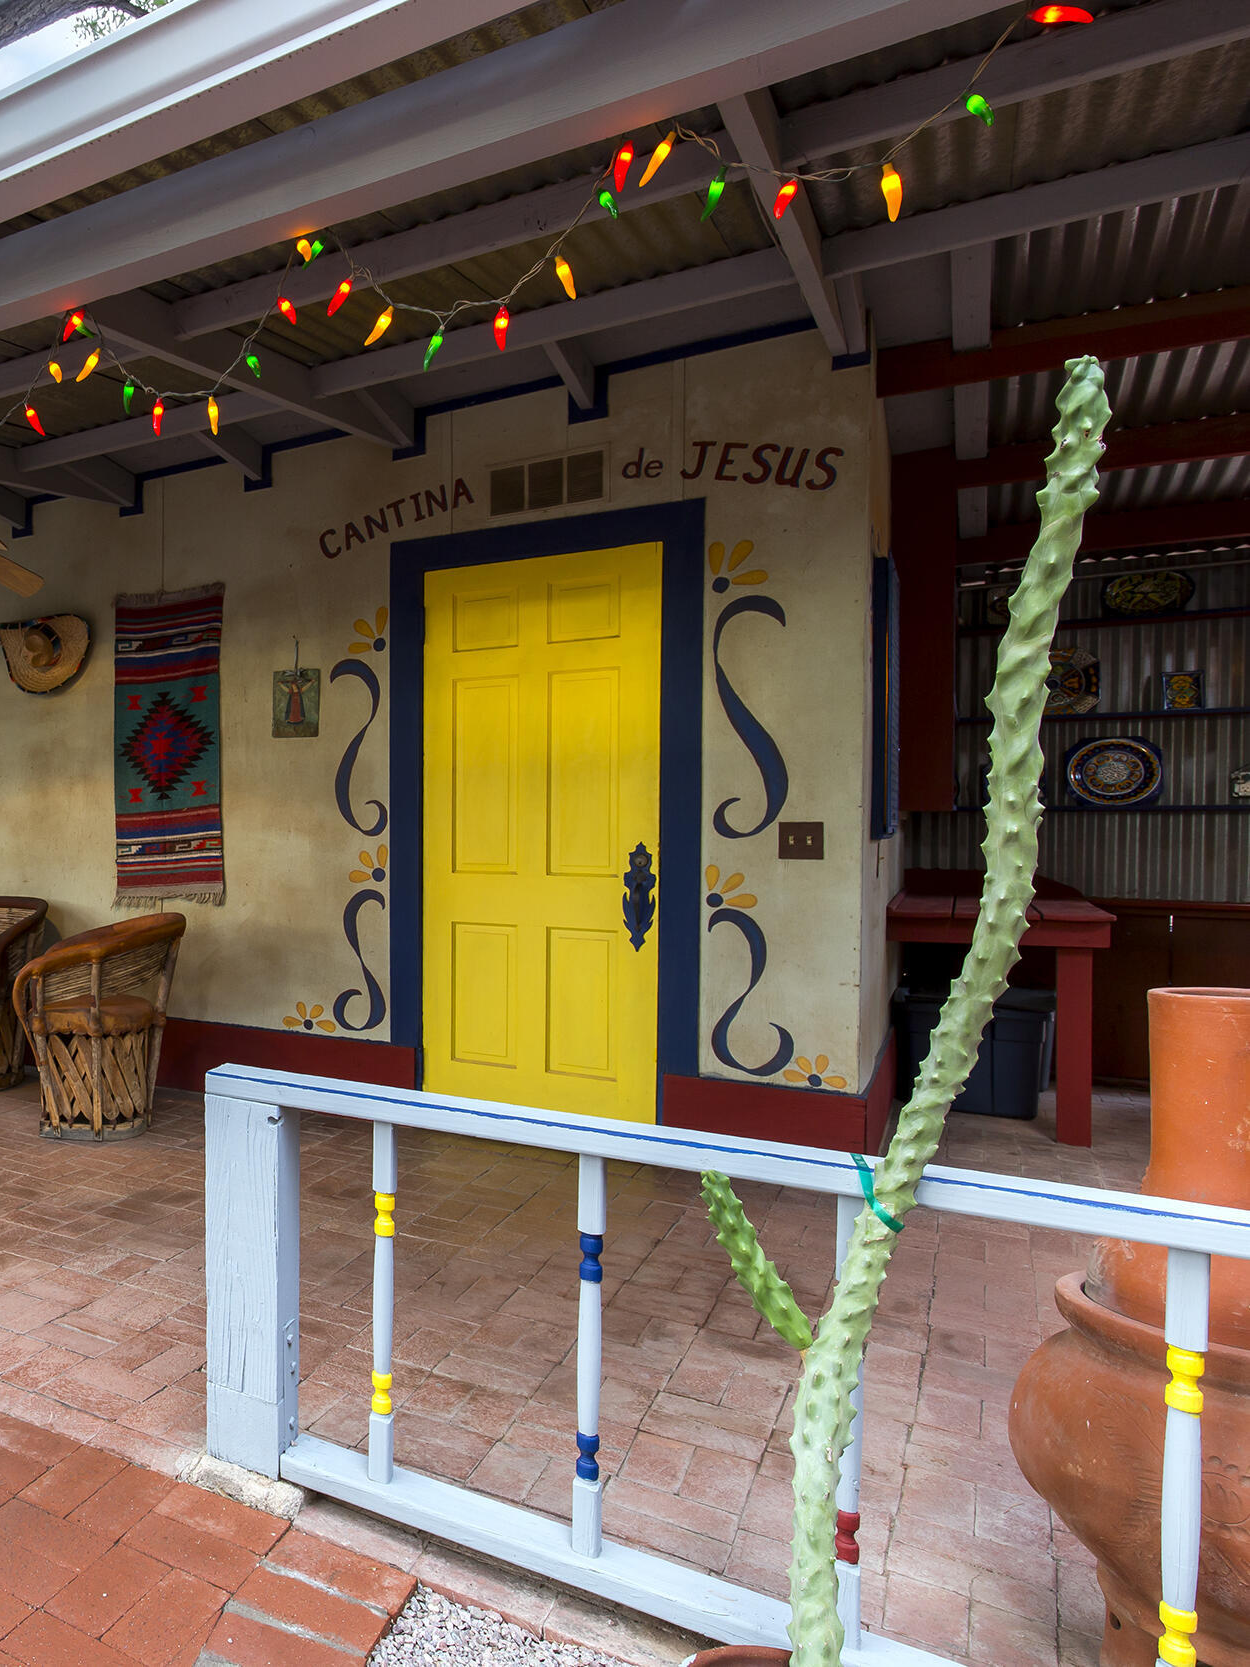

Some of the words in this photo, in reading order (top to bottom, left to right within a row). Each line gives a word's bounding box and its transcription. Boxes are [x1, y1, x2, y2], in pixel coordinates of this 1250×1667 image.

[319, 477, 475, 560] CANTINA
[621, 447, 664, 479] de
[680, 440, 845, 491] JESUS
